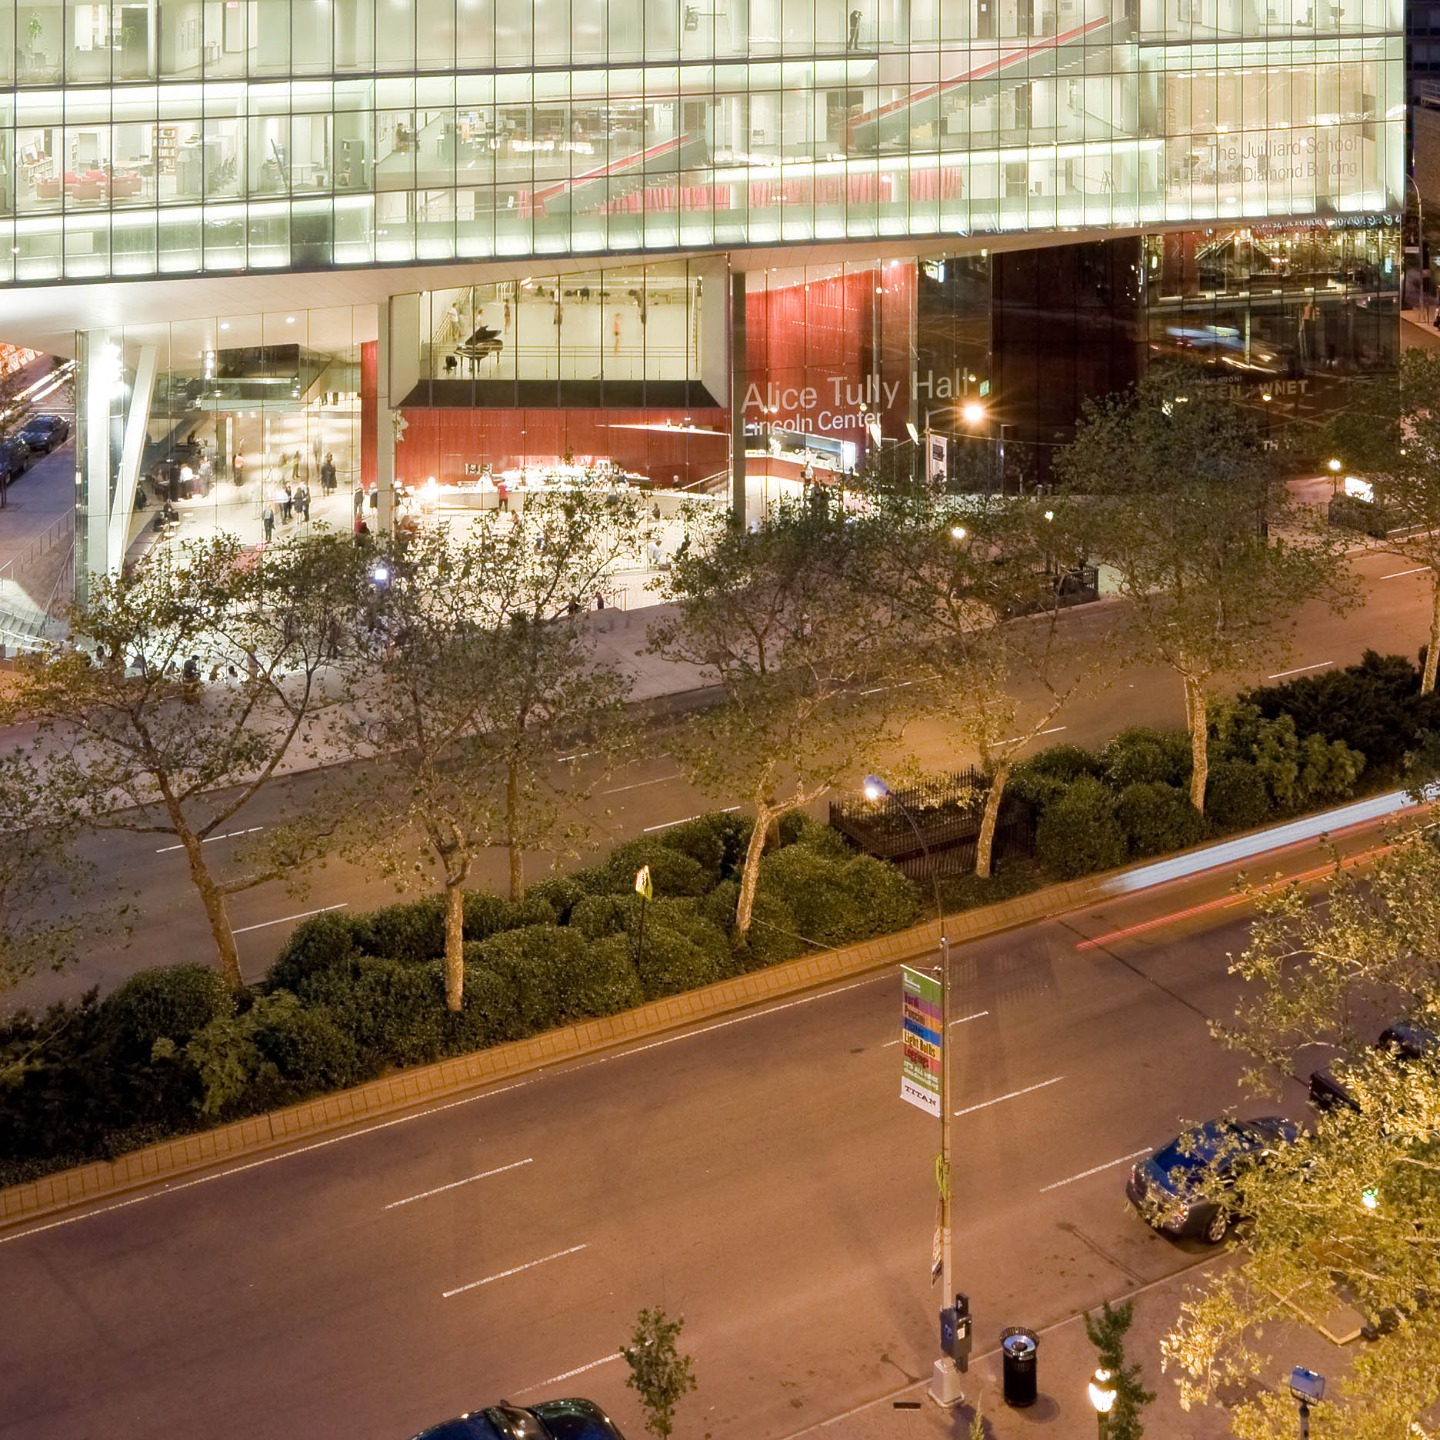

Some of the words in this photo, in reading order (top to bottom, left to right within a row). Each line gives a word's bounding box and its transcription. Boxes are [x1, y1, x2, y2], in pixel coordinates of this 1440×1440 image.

[1207, 143, 1237, 161] The
[1243, 139, 1301, 160] Juilliard
[1306, 136, 1358, 155] School
[1243, 162, 1302, 183] Diamond
[741, 381, 817, 413] Alice
[827, 374, 900, 408] Tully
[912, 367, 968, 400] Hall
[1259, 379, 1309, 396] WNET
[743, 416, 813, 436] Lincoln
[818, 411, 883, 431] Center
[904, 1084, 936, 1107] TITAN
